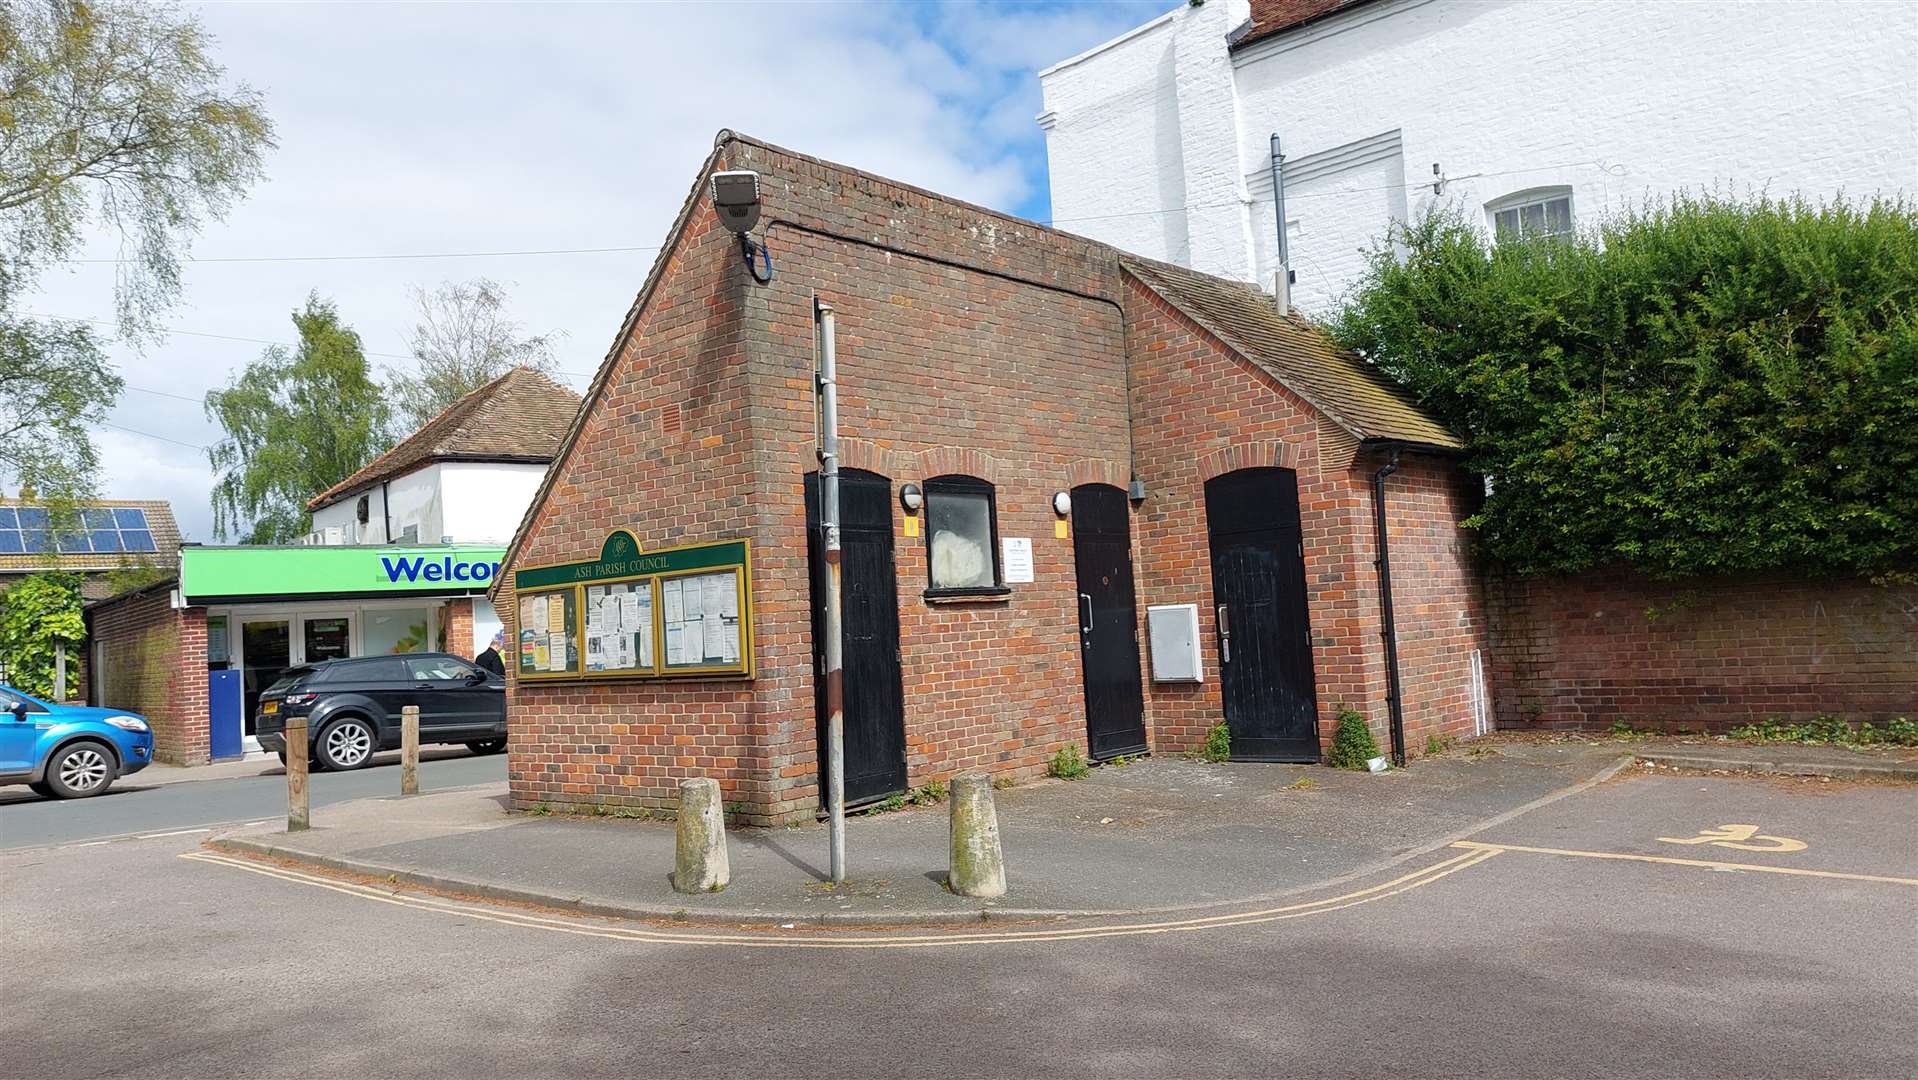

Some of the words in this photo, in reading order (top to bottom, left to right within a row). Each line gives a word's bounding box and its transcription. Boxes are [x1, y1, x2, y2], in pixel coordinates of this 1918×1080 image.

[574, 566, 592, 578] ASH
[595, 562, 626, 577] PARISH
[629, 556, 670, 573] COUNCIL
